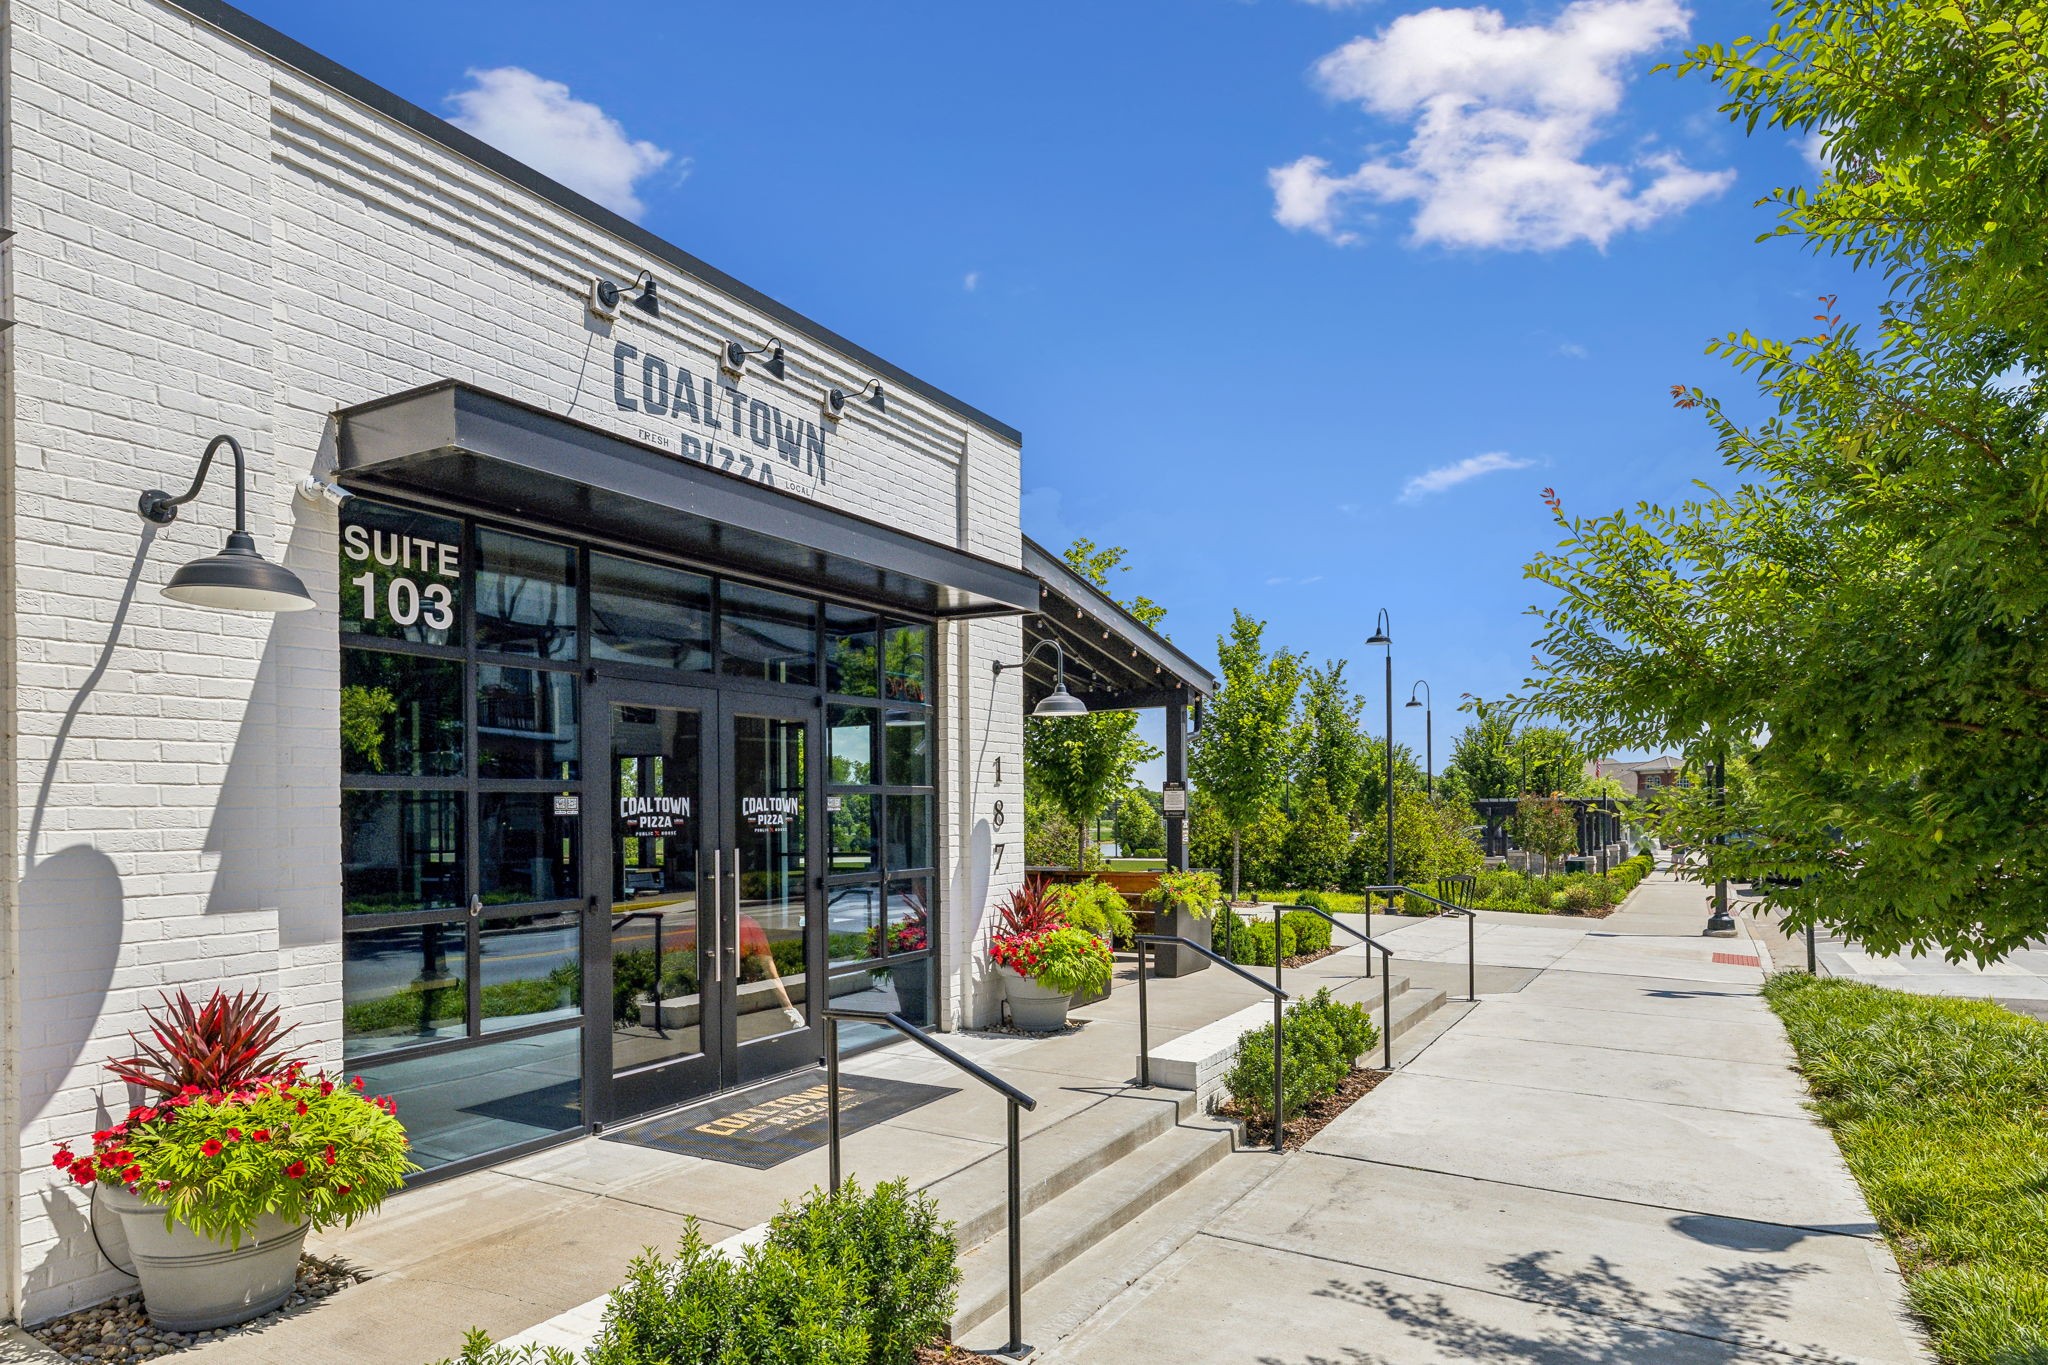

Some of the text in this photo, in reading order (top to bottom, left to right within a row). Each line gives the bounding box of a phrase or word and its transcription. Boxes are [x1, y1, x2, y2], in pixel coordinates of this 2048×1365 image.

[614, 340, 826, 486] COALTOWN
[638, 429, 669, 447] FRESH
[785, 481, 810, 497] LOCAL
[344, 525, 460, 577] SUITE
[353, 572, 454, 630] 103
[620, 797, 690, 818] COALTOWN
[742, 797, 798, 816] COALTOWN
[639, 816, 673, 828] PIZZA
[757, 814, 784, 825] PIZZA
